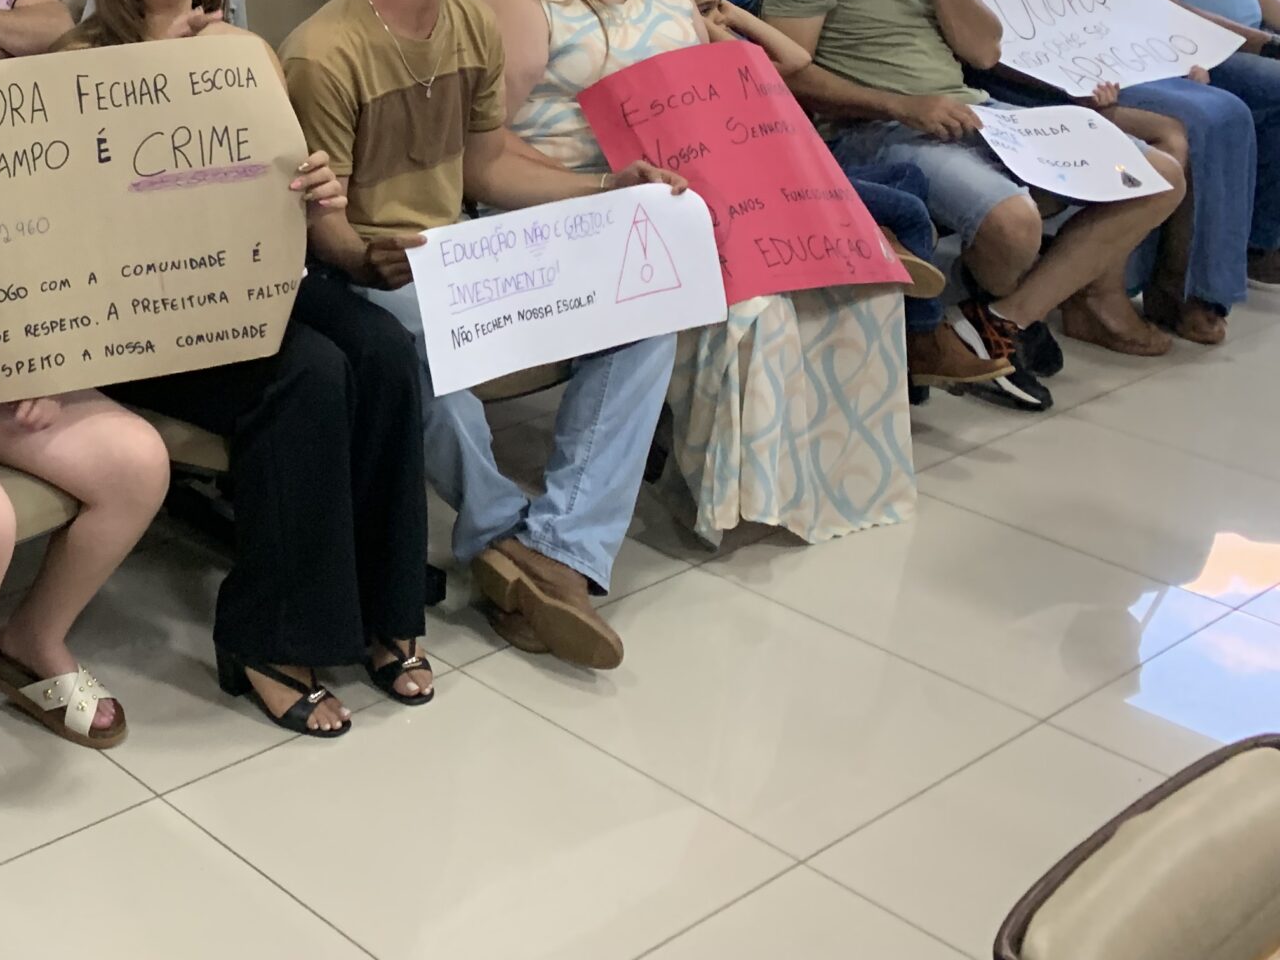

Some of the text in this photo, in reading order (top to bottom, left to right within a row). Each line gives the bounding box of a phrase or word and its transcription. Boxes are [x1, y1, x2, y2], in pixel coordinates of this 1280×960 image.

[76, 73, 171, 114] FECHAR
[189, 67, 258, 96] ESCOLA
[620, 83, 721, 128] ESCOLA
[96, 127, 112, 164] É
[133, 125, 251, 177] CRIME
[728, 198, 765, 220] ANOS
[439, 223, 517, 268] EDUCAÇÃO
[523, 220, 551, 246] NÃO
[40, 278, 71, 293] COM
[87, 272, 98, 285] A
[121, 250, 227, 278] COMUNIDADE
[252, 242, 262, 262] É
[106, 301, 120, 321] A
[131, 290, 230, 315] PREFEITURA
[247, 279, 298, 301] FALTOU
[81, 349, 92, 362] A
[104, 340, 156, 357] NOSSA
[176, 323, 268, 348] COMUNIDADE
[450, 325, 473, 350] NÃO
[474, 314, 513, 339] FECHEM
[517, 304, 554, 322] NOSSA
